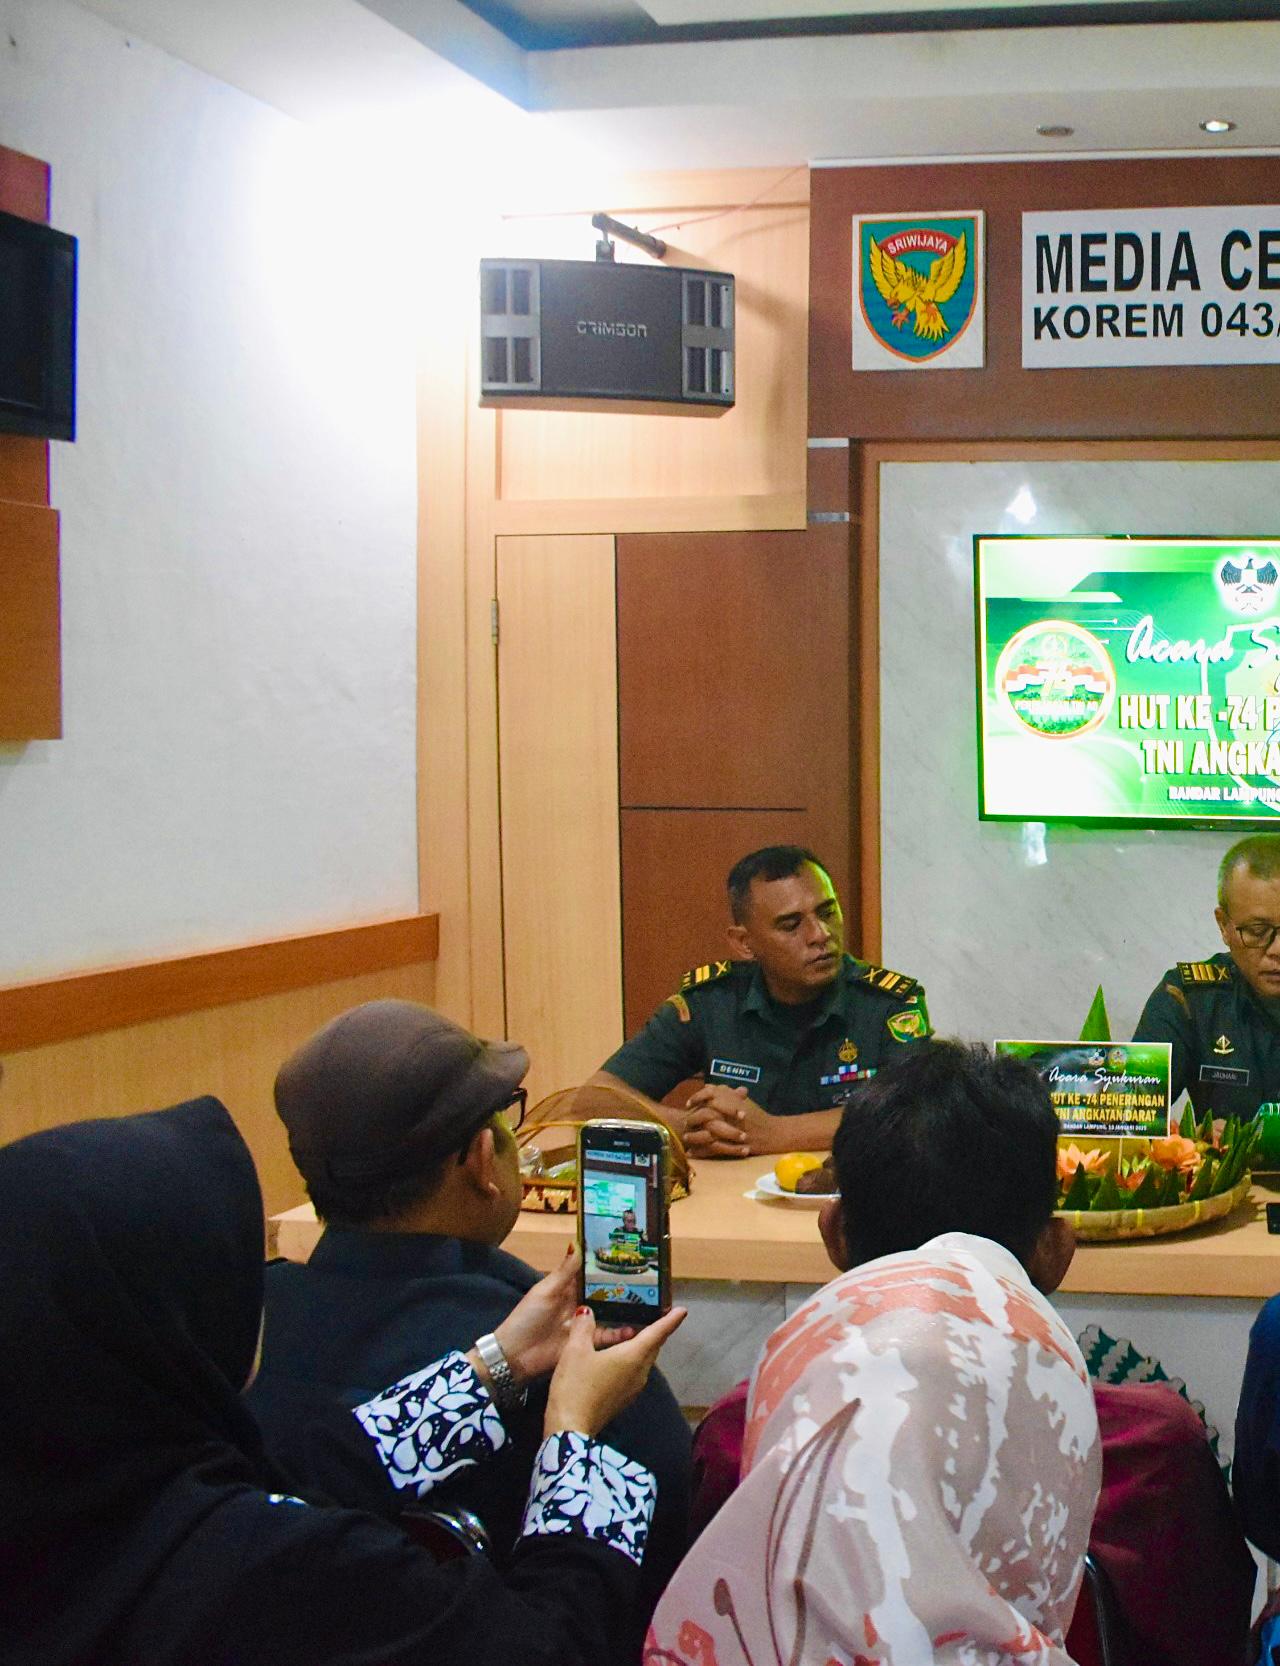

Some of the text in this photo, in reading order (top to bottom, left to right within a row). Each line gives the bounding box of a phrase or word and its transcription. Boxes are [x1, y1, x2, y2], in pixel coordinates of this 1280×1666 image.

[887, 234, 948, 254] SRIWIJAYA
[1035, 231, 1201, 294] MEDIA
[1033, 303, 1184, 341] KOREM
[1119, 695, 1170, 729] HUT
[1176, 695, 1211, 730] KE
[1217, 696, 1258, 730] -74
[1141, 739, 1184, 774] TNI
[719, 1064, 752, 1077] DENNY
[1048, 1065, 1161, 1092] Acara Syukuran
[1051, 1092, 1164, 1107] UT KE -74 PENERANGAN
[1072, 1108, 1122, 1121] ANGKATAN
[1124, 1109, 1156, 1122] DARAT
